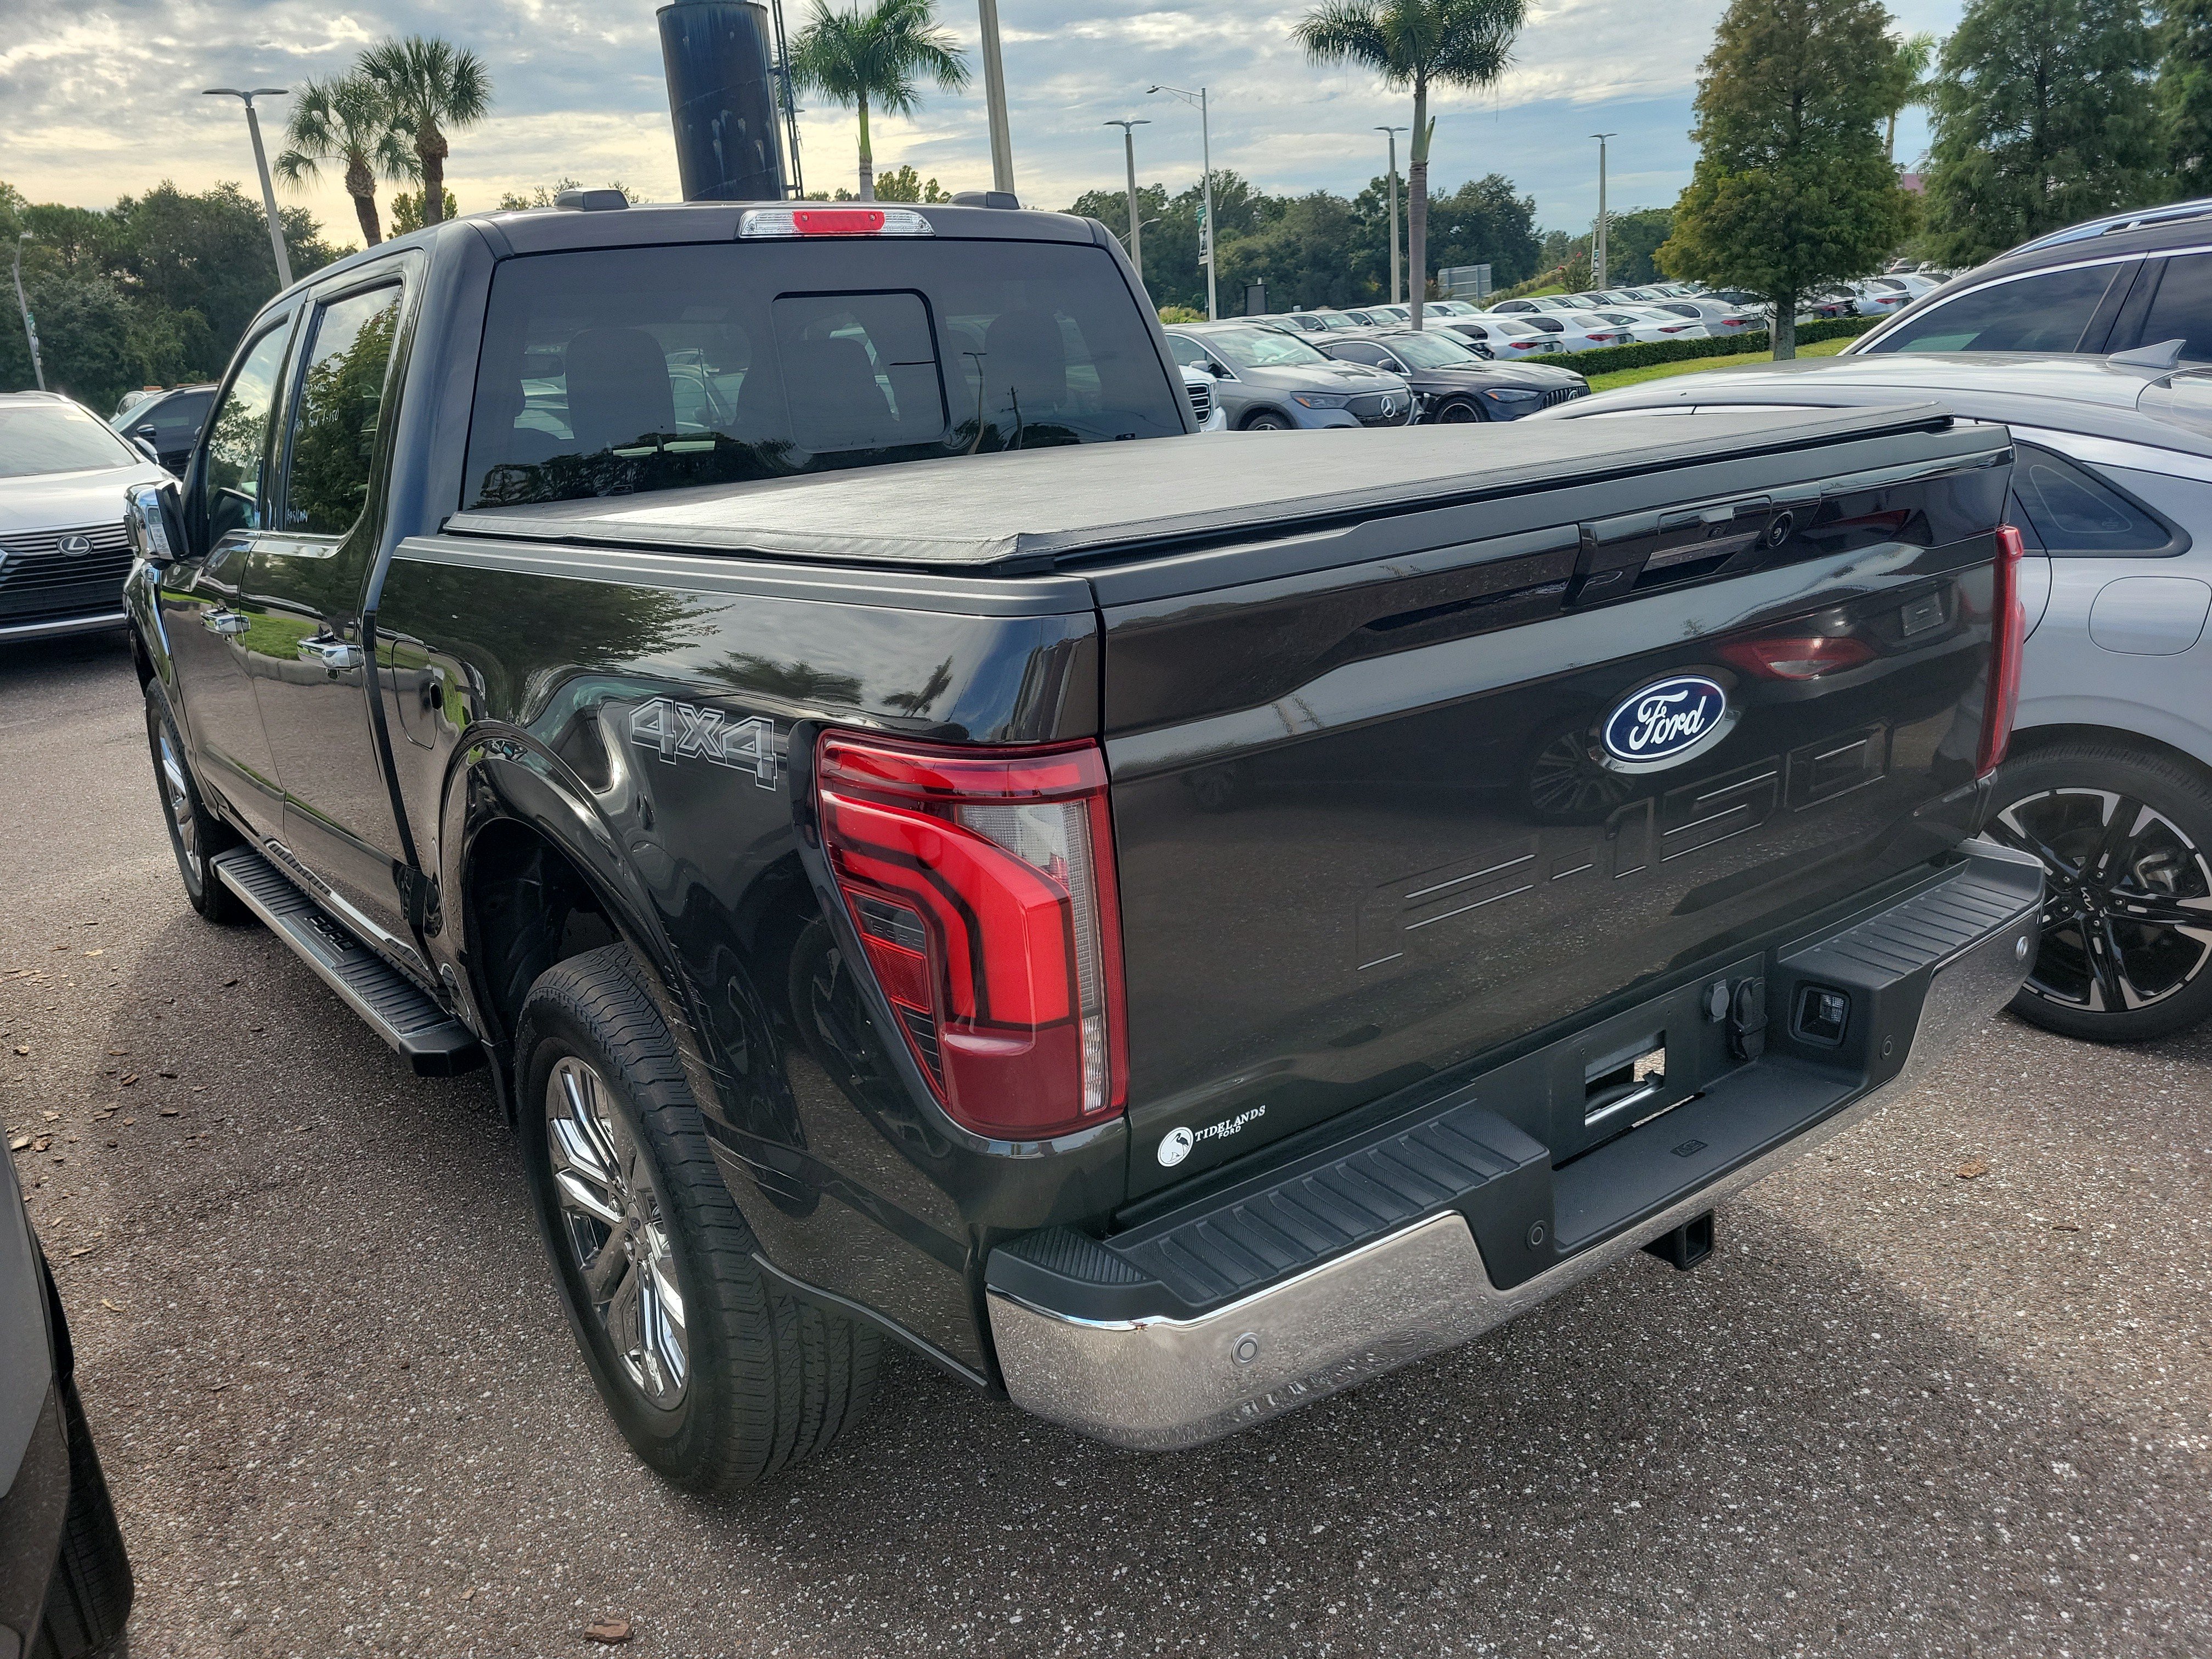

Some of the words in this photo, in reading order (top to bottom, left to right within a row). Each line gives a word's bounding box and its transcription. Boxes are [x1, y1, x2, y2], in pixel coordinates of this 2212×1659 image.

[1629, 690, 1705, 751] Ford
[304, 916, 354, 953] FORD
[1195, 1105, 1266, 1142] TIDELANDS
[1218, 1125, 1242, 1139] FORD
